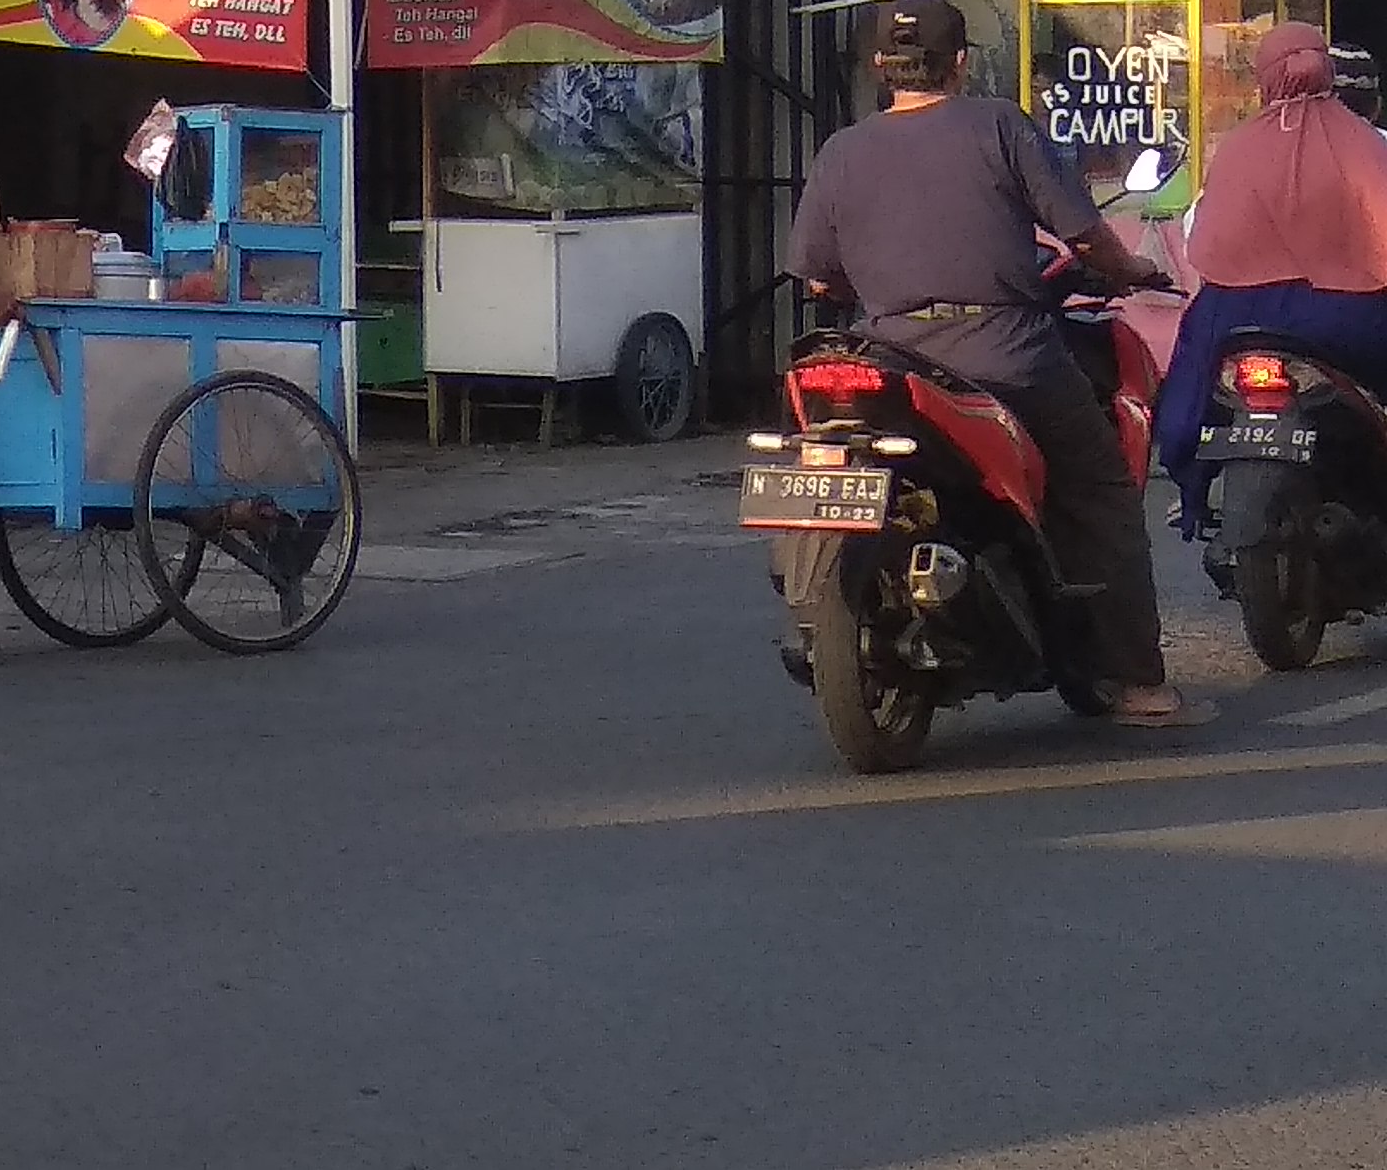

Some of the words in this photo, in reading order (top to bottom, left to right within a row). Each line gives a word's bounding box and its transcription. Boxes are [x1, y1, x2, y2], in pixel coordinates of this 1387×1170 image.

[189, 17, 212, 36] ES
[254, 23, 287, 43] DLL
[1081, 84, 1156, 105] JUICE
[1050, 108, 1190, 145] CAMPUR
[752, 474, 766, 495] N
[779, 475, 833, 498] 3696
